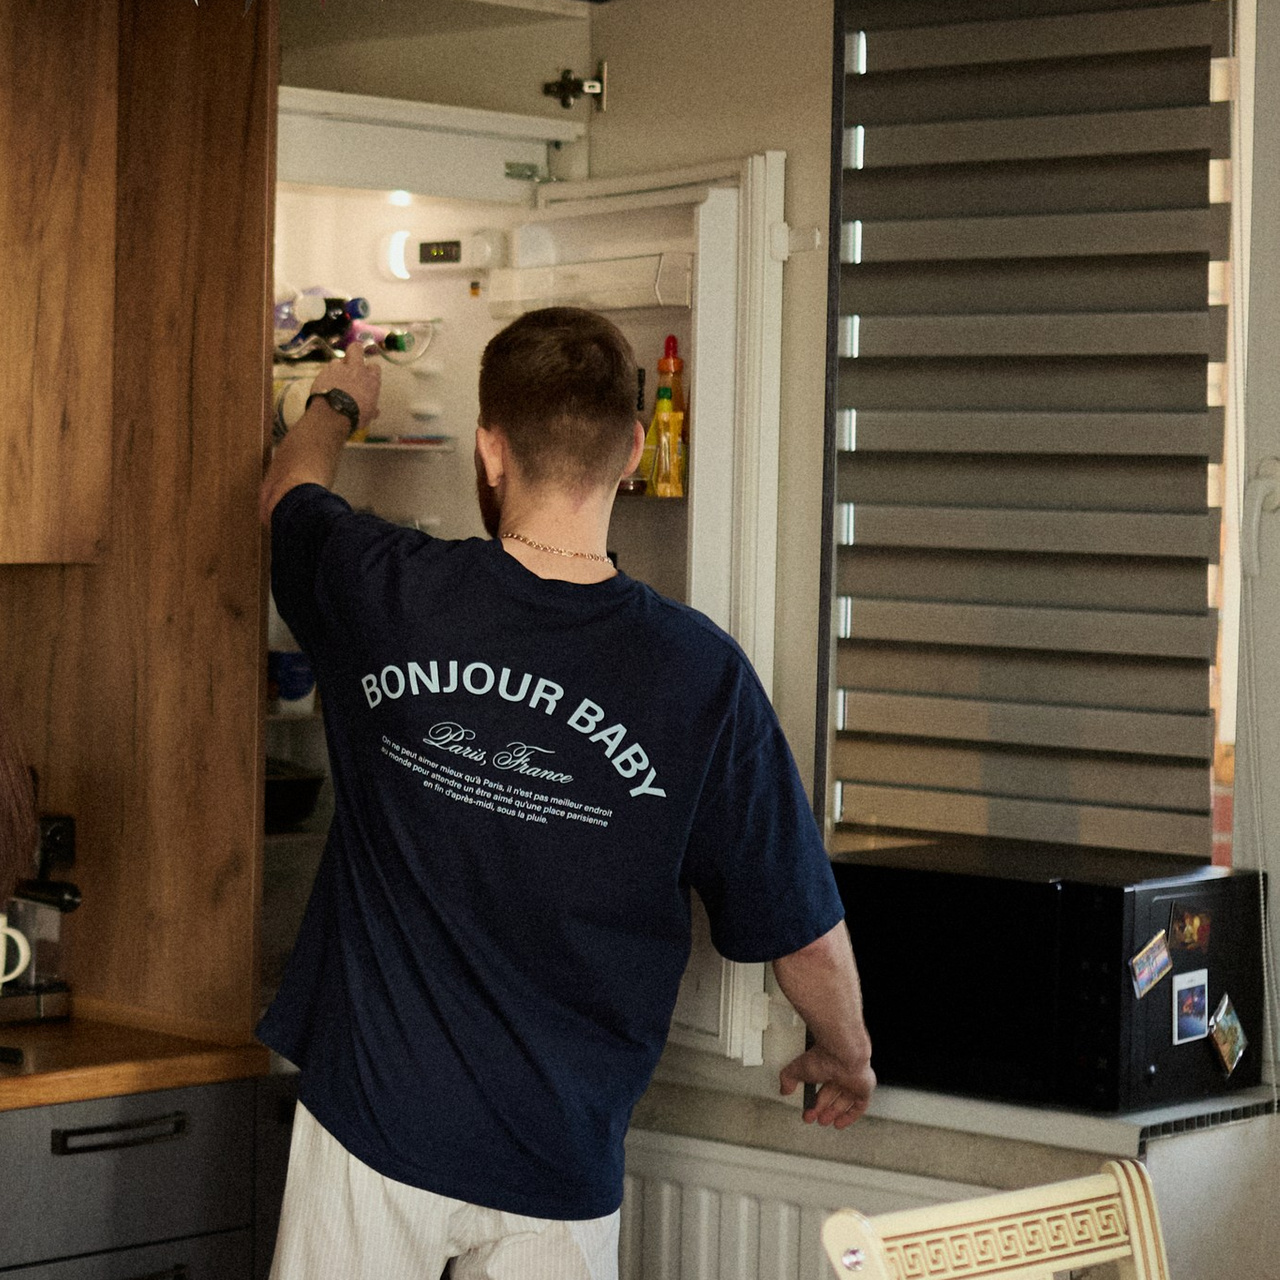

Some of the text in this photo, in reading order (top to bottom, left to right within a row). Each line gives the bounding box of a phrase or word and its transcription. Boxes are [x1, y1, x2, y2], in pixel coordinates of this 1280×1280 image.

[361, 660, 667, 798] BONJOUR BABY
[422, 721, 574, 784] Paris, France
[381, 735, 391, 746] On
[391, 742, 401, 751] ne
[400, 747, 418, 760] peut
[418, 755, 439, 769] aimer
[440, 765, 464, 780] mieux
[482, 778, 505, 792] Paris,
[506, 784, 513, 793] il
[513, 788, 533, 799] n'est
[533, 793, 549, 803] pas
[549, 797, 583, 810] meilleur
[583, 805, 613, 817] endroit
[388, 751, 412, 768] monde
[412, 764, 430, 776] pour
[430, 772, 462, 790] attendre
[463, 785, 474, 794] un
[475, 787, 492, 799] être
[492, 793, 514, 805] aimé
[514, 800, 542, 812] qu'une
[542, 806, 566, 817] place
[566, 812, 609, 827] parisienne
[423, 780, 434, 789] en
[434, 783, 444, 794] fin
[496, 805, 516, 817] sous
[517, 810, 525, 819] la
[526, 813, 548, 824] pluie.
